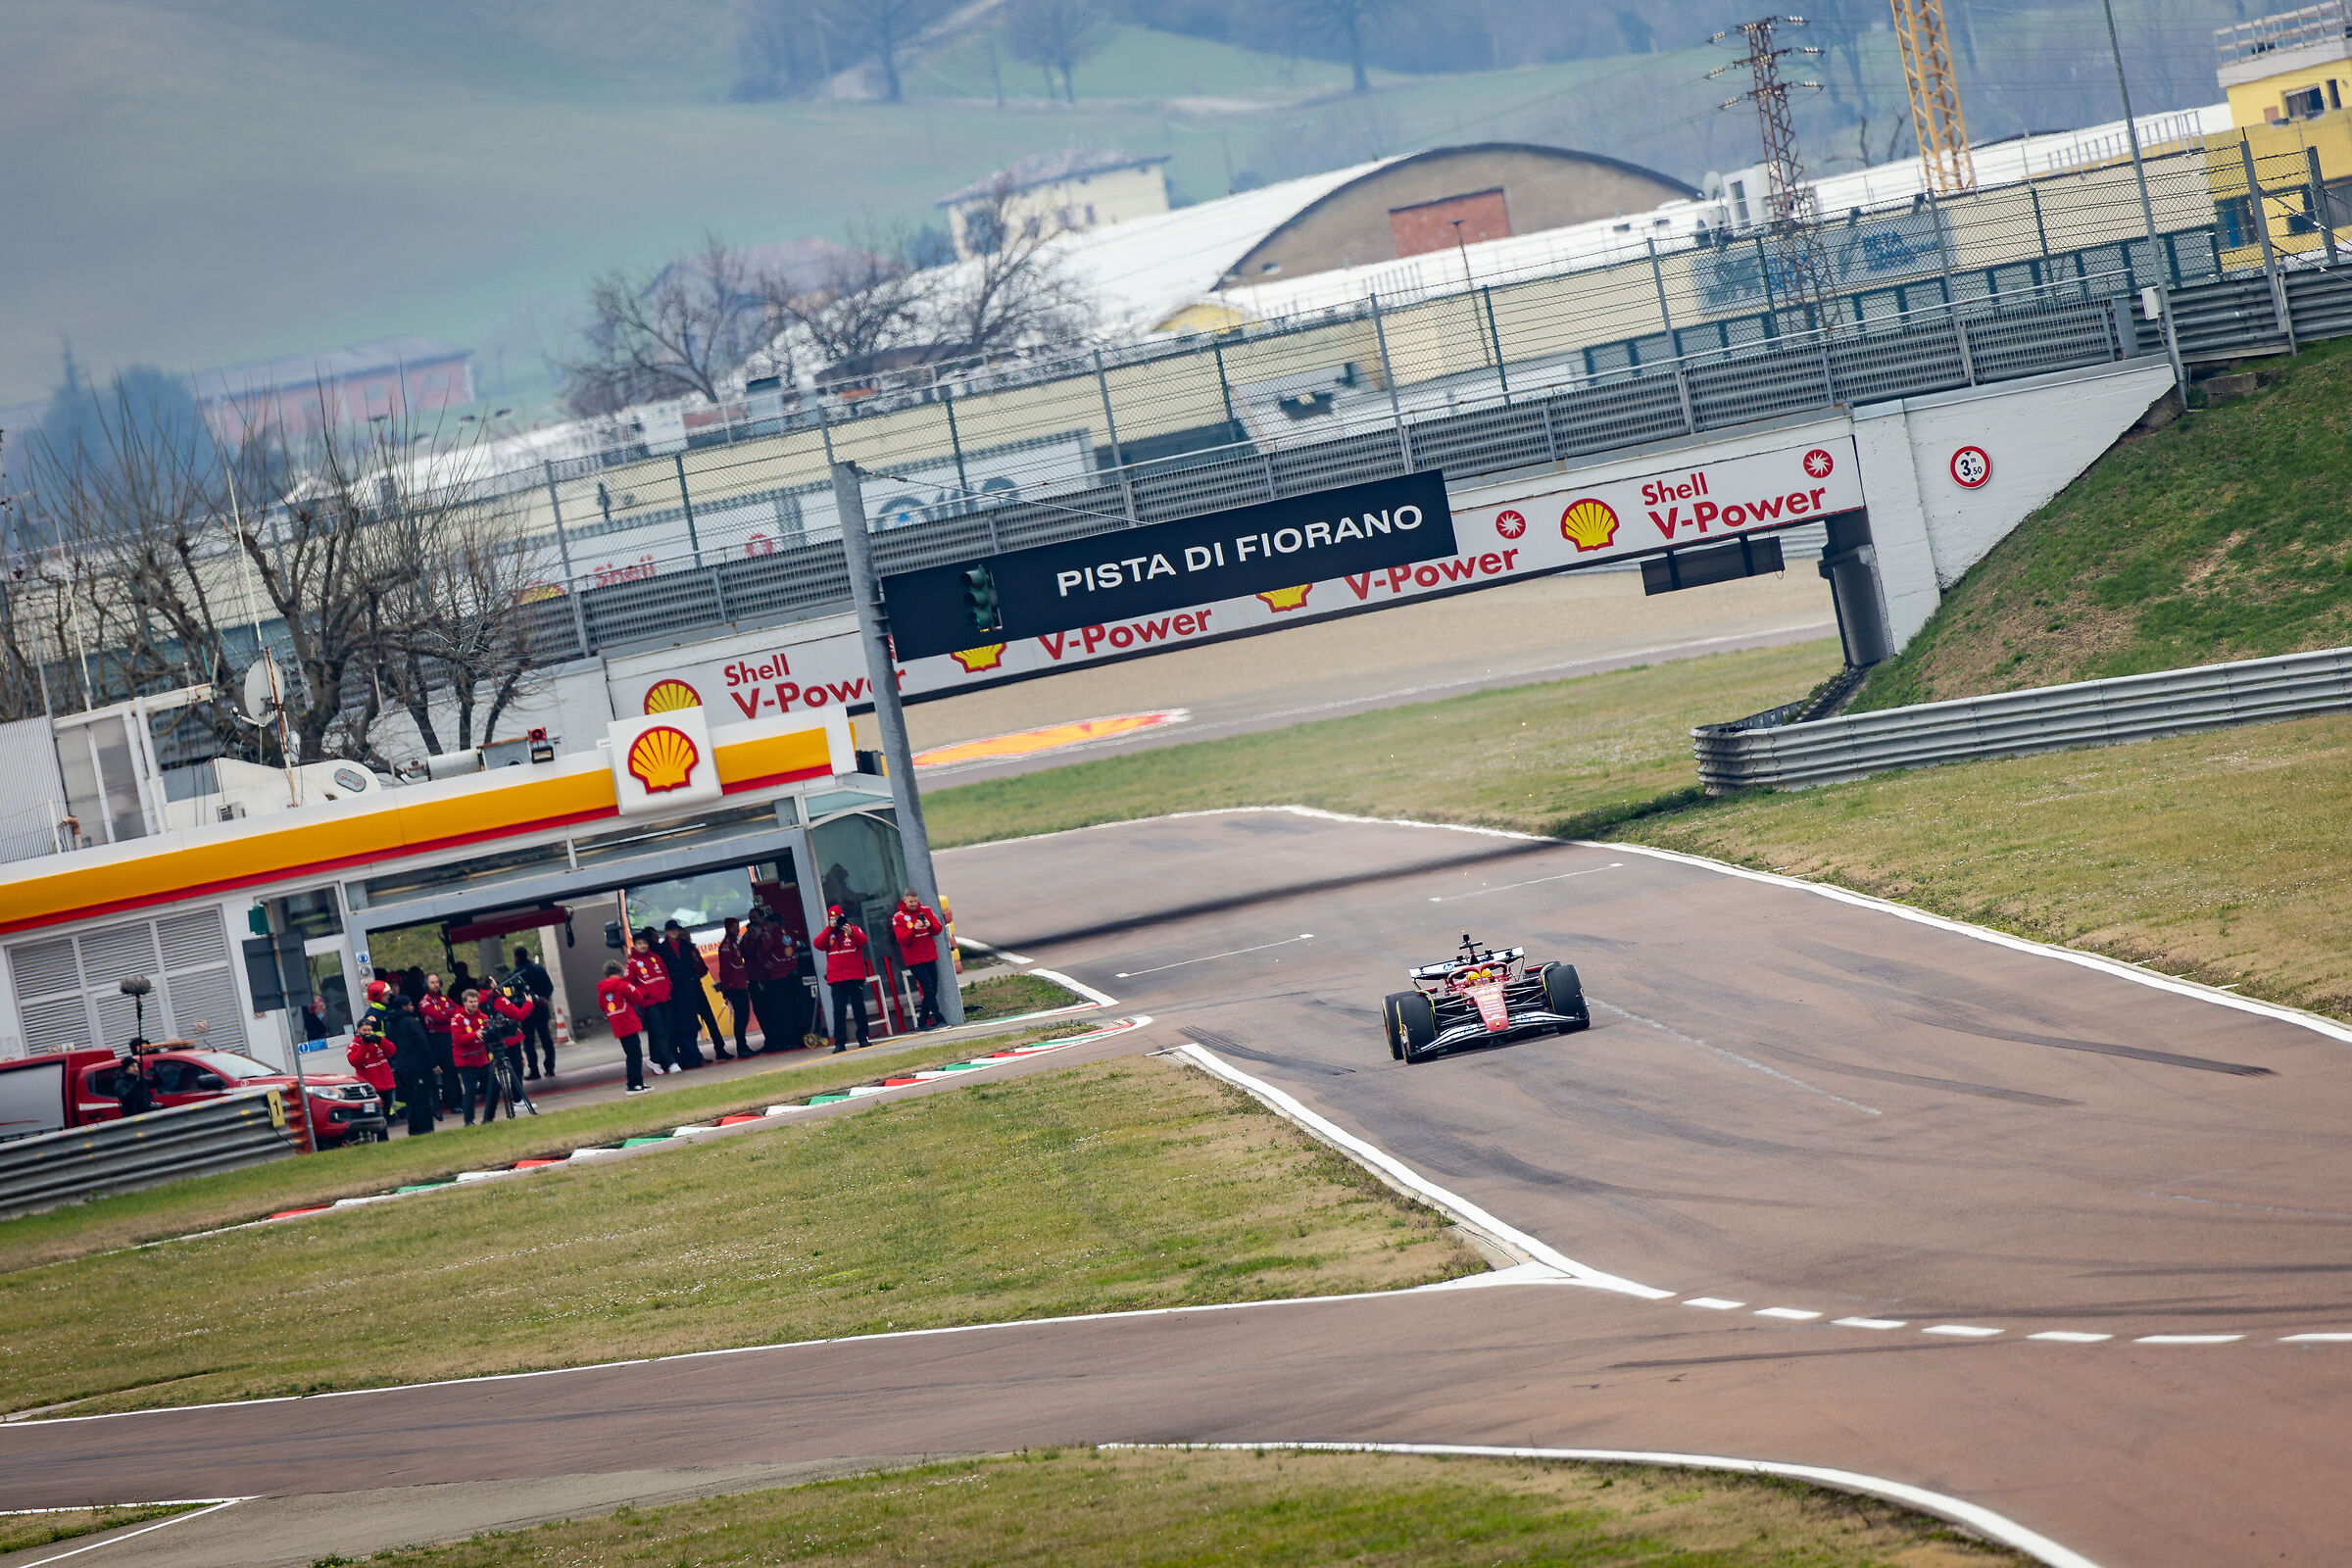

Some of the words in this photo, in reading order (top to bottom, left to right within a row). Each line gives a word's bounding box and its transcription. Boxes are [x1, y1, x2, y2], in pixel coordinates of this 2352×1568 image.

[1642, 471, 1709, 507] Shell
[1647, 487, 1826, 540] V-Power
[1056, 553, 1177, 597] PISTA
[1184, 542, 1225, 572] DI
[1236, 505, 1423, 563] FIORANO
[1344, 548, 1519, 601] V-Power
[1036, 609, 1212, 661] V-Power
[723, 653, 791, 687] Shell
[730, 668, 906, 719] V-Powr
